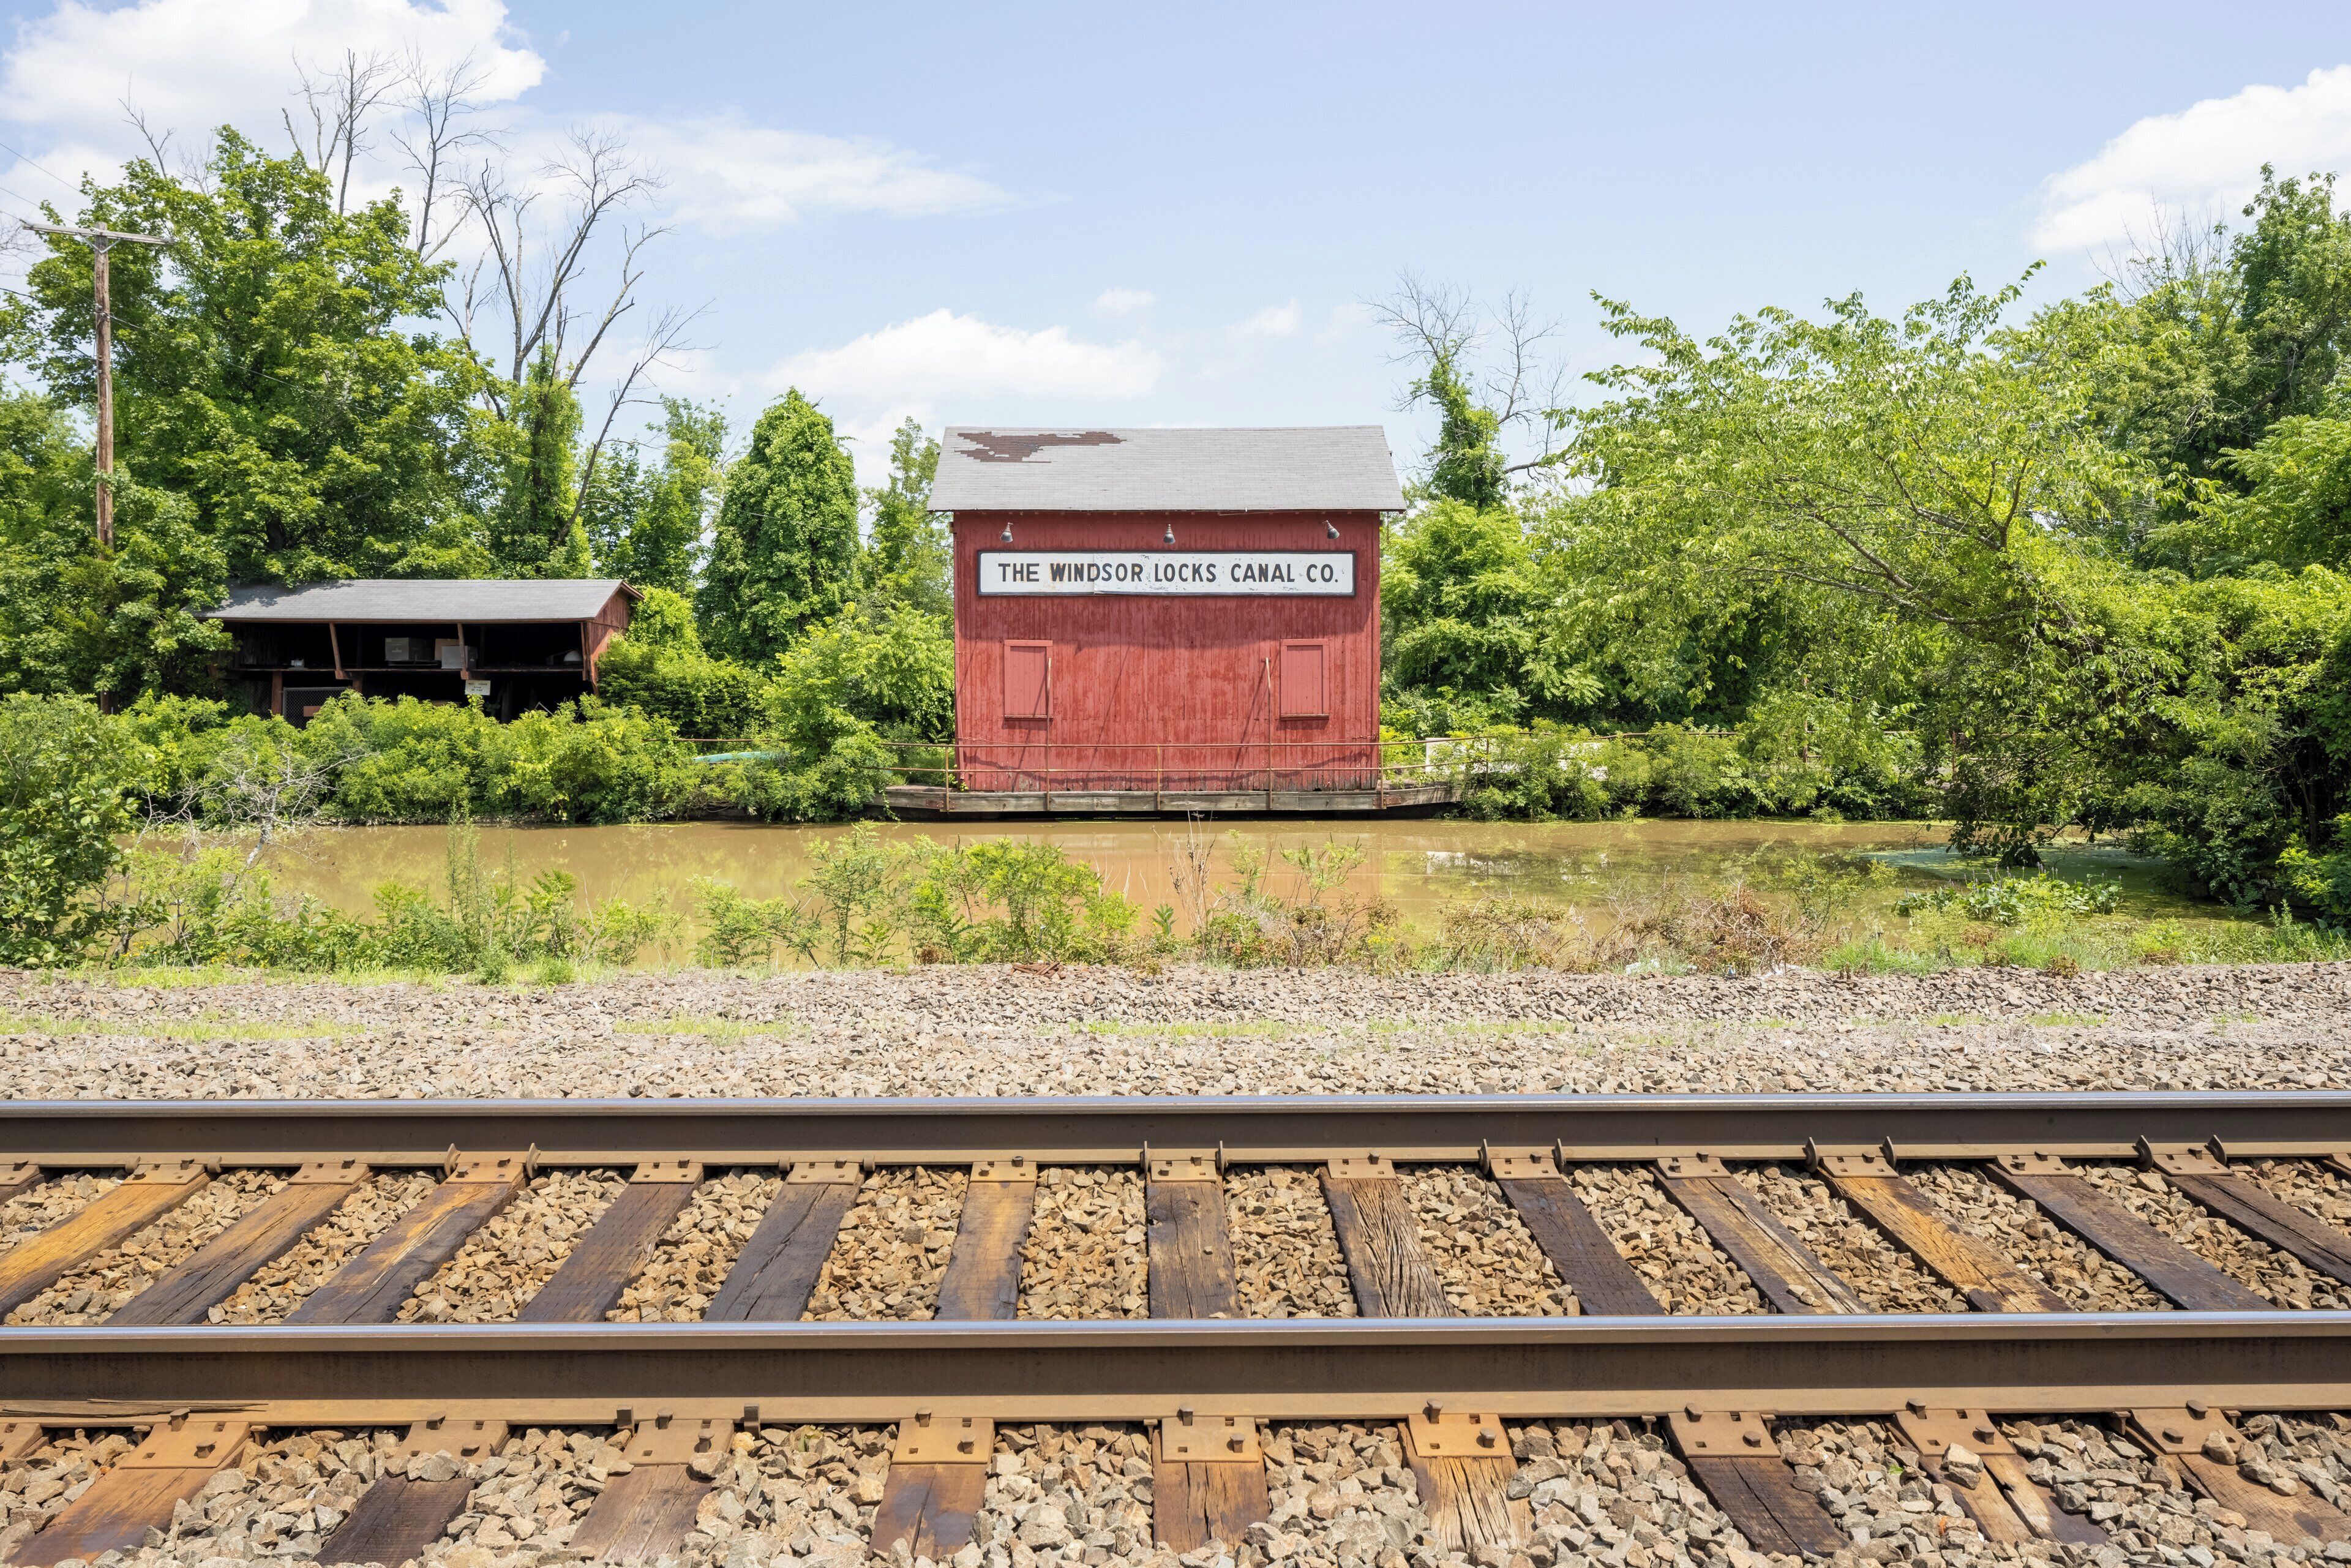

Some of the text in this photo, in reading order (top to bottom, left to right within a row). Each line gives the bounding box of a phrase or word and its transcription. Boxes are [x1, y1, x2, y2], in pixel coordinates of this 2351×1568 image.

[998, 563, 1339, 583] THE WINDSOR LOCKS CANAL CO.
